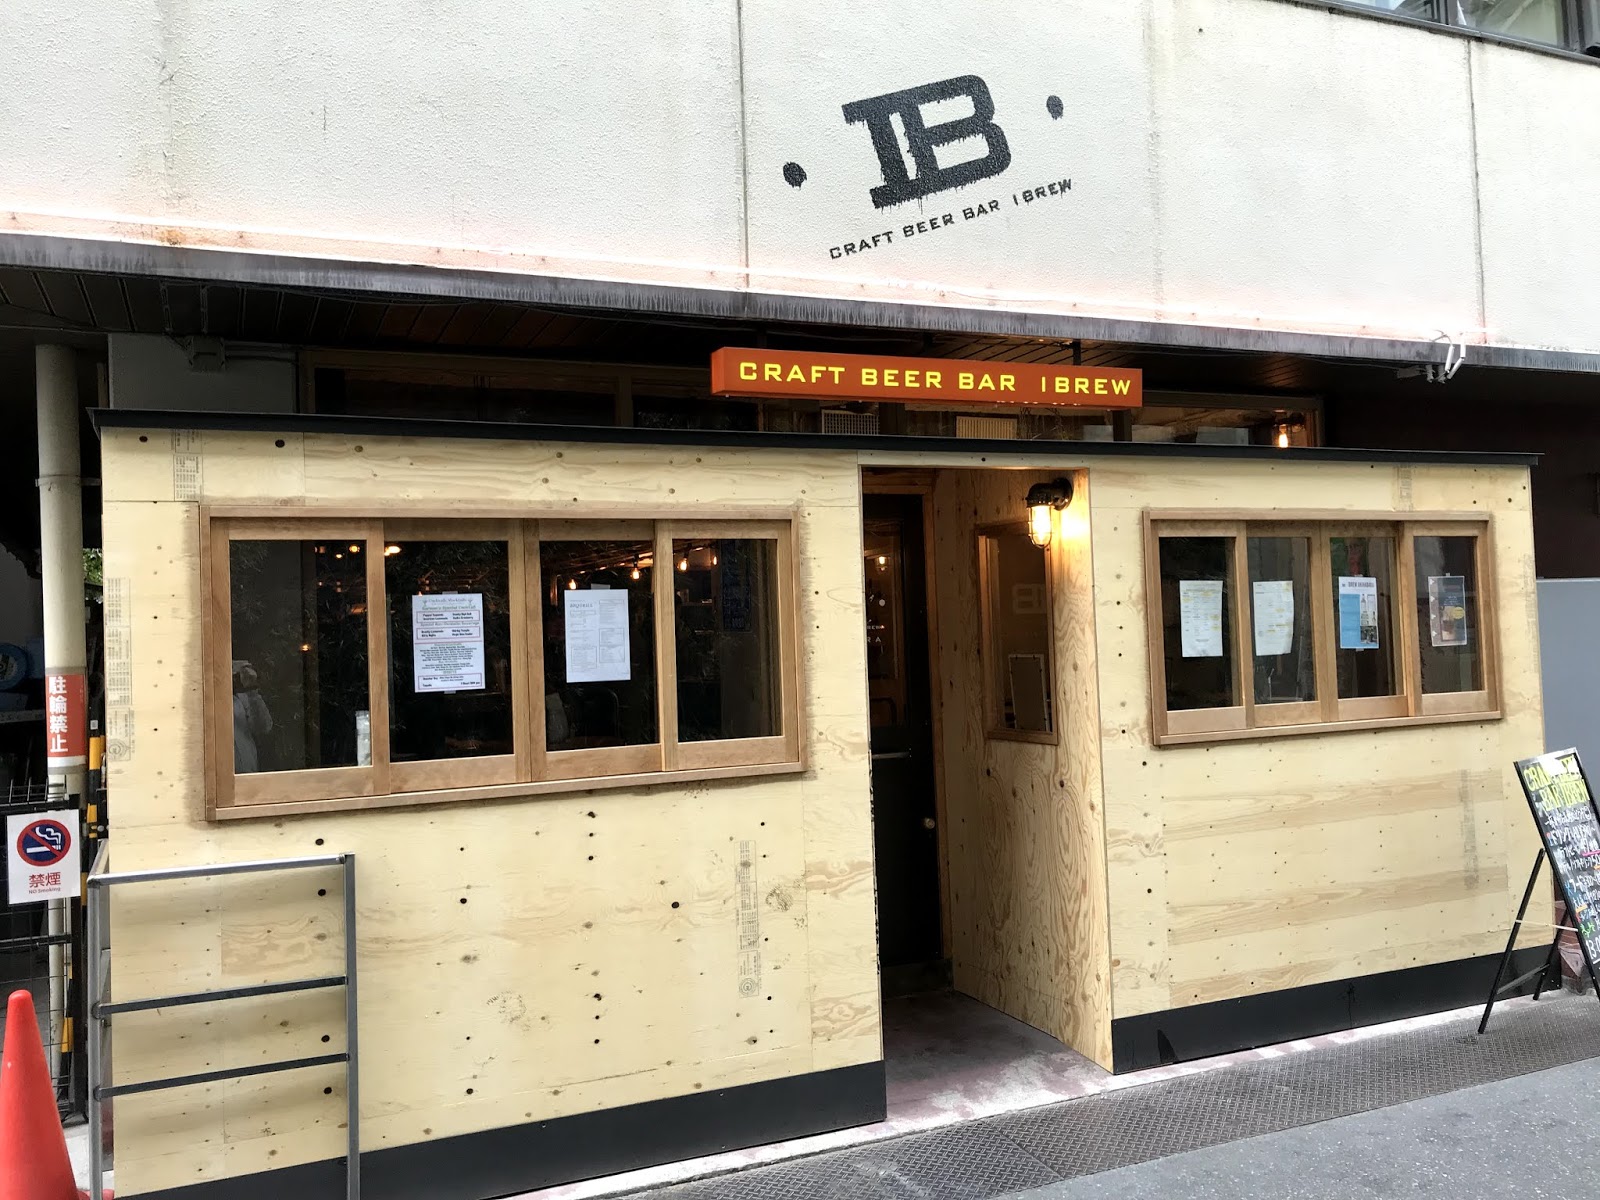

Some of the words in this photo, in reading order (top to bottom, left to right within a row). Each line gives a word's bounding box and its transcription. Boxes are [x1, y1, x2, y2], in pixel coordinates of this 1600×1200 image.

[829, 230, 894, 260] CRAFT
[902, 213, 955, 238] BEER
[962, 199, 1001, 221] BAR
[739, 362, 845, 385] CRAFT
[861, 368, 942, 389] BEER
[958, 372, 1016, 391] BAR
[49, 675, 69, 752] 駐輪禁止
[28, 871, 61, 888] 禁煙
